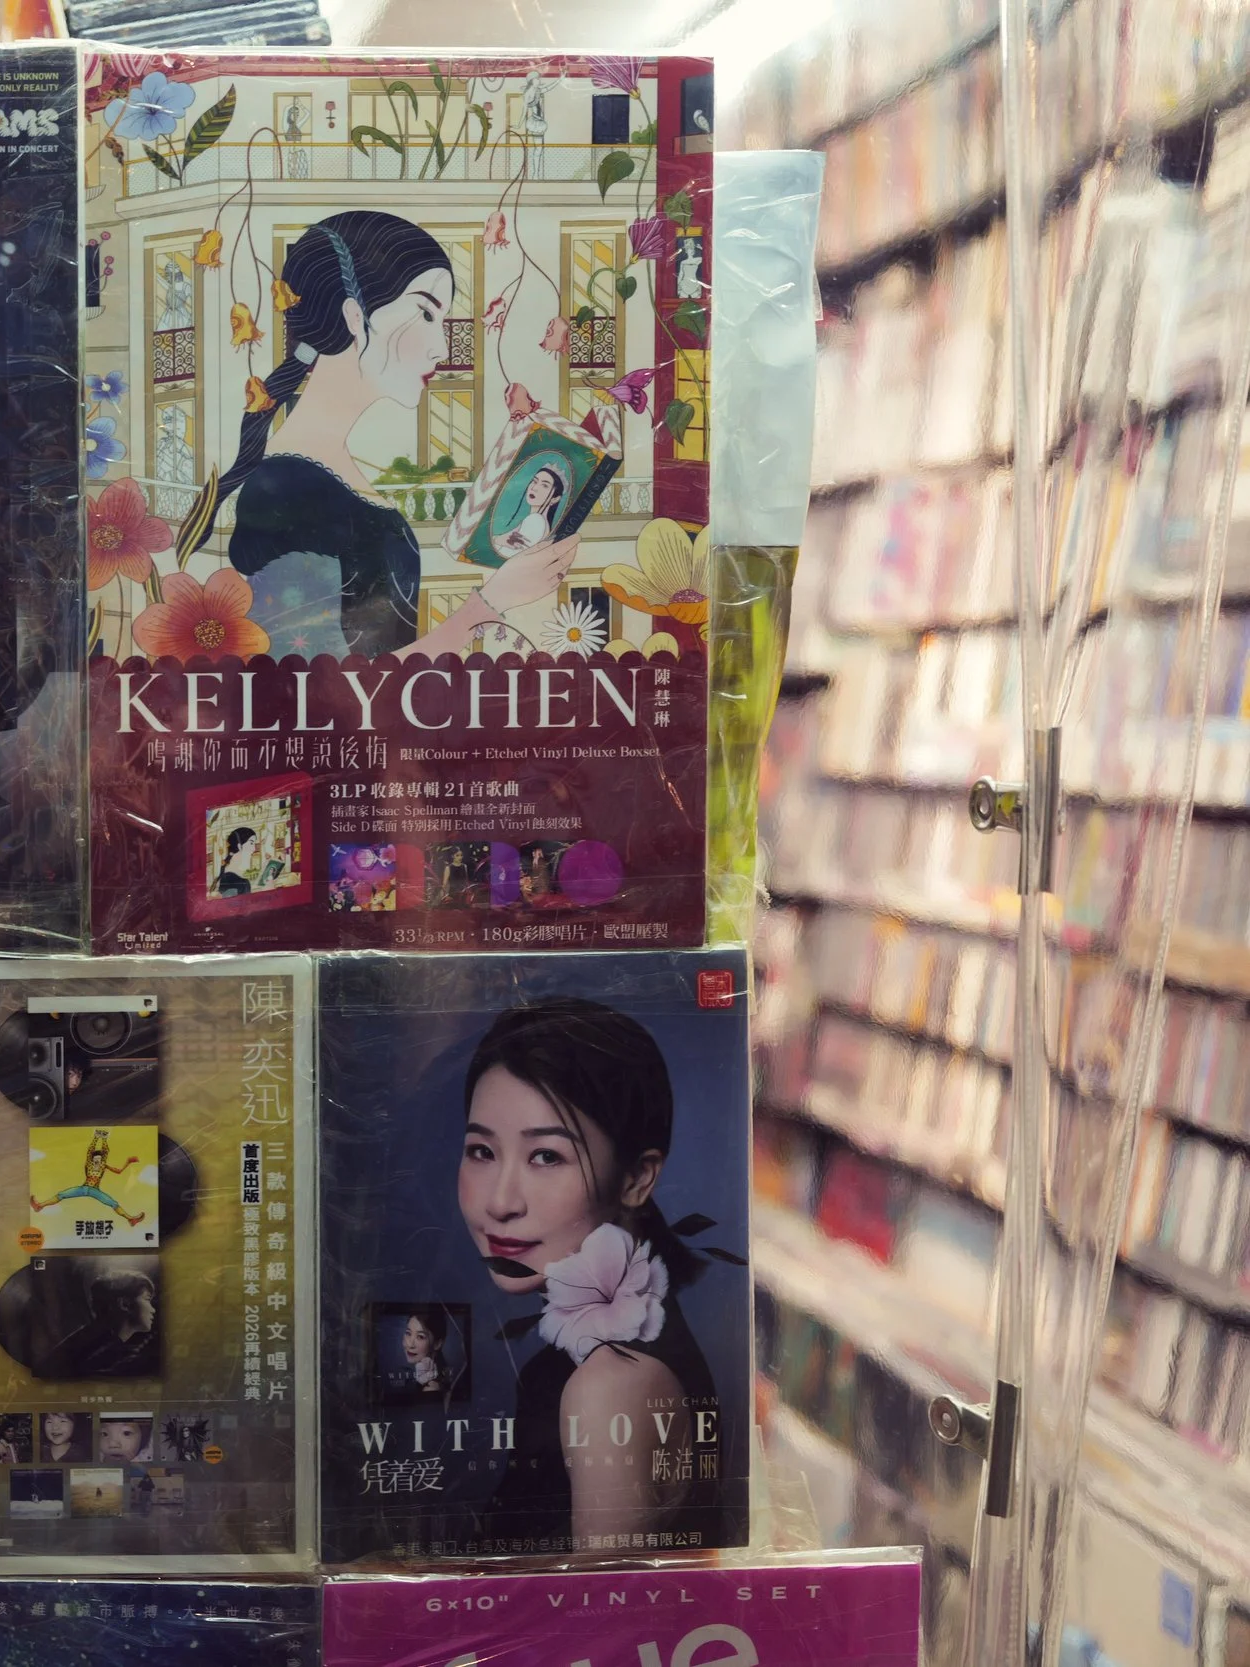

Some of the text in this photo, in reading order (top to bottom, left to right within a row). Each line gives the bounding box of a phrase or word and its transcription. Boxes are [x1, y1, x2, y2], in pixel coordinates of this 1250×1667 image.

[4, 73, 12, 81] IS
[13, 72, 59, 80] UNKNOWN
[0, 84, 22, 92] ONLY
[23, 84, 59, 92] REALITY
[8, 145, 16, 153] IN
[18, 144, 59, 152] CONCERT
[654, 668, 671, 728] 陳慧琳
[486, 747, 528, 759] Etched
[532, 747, 568, 760] Vinyl
[572, 746, 616, 758] Deluxe
[621, 746, 660, 758] Boxset
[330, 784, 367, 798] 3LP
[372, 806, 400, 816] Isaac
[404, 804, 458, 817] Spellman
[331, 821, 356, 832] Side
[361, 822, 370, 832] D
[454, 818, 495, 830] Etched
[500, 818, 530, 831] Vinyl
[437, 931, 464, 942] RPM
[242, 980, 288, 1126] 陳奕迅
[242, 1144, 260, 1204] 首度出版
[266, 1142, 287, 1401] 三款傳奇級中文唱片
[646, 1396, 720, 1409] LILY CHAN
[358, 1410, 718, 1454] WITH LOVE
[652, 1448, 718, 1482] 陈洁丽
[548, 1588, 694, 1608] VINYL
[736, 1585, 822, 1600] SET
